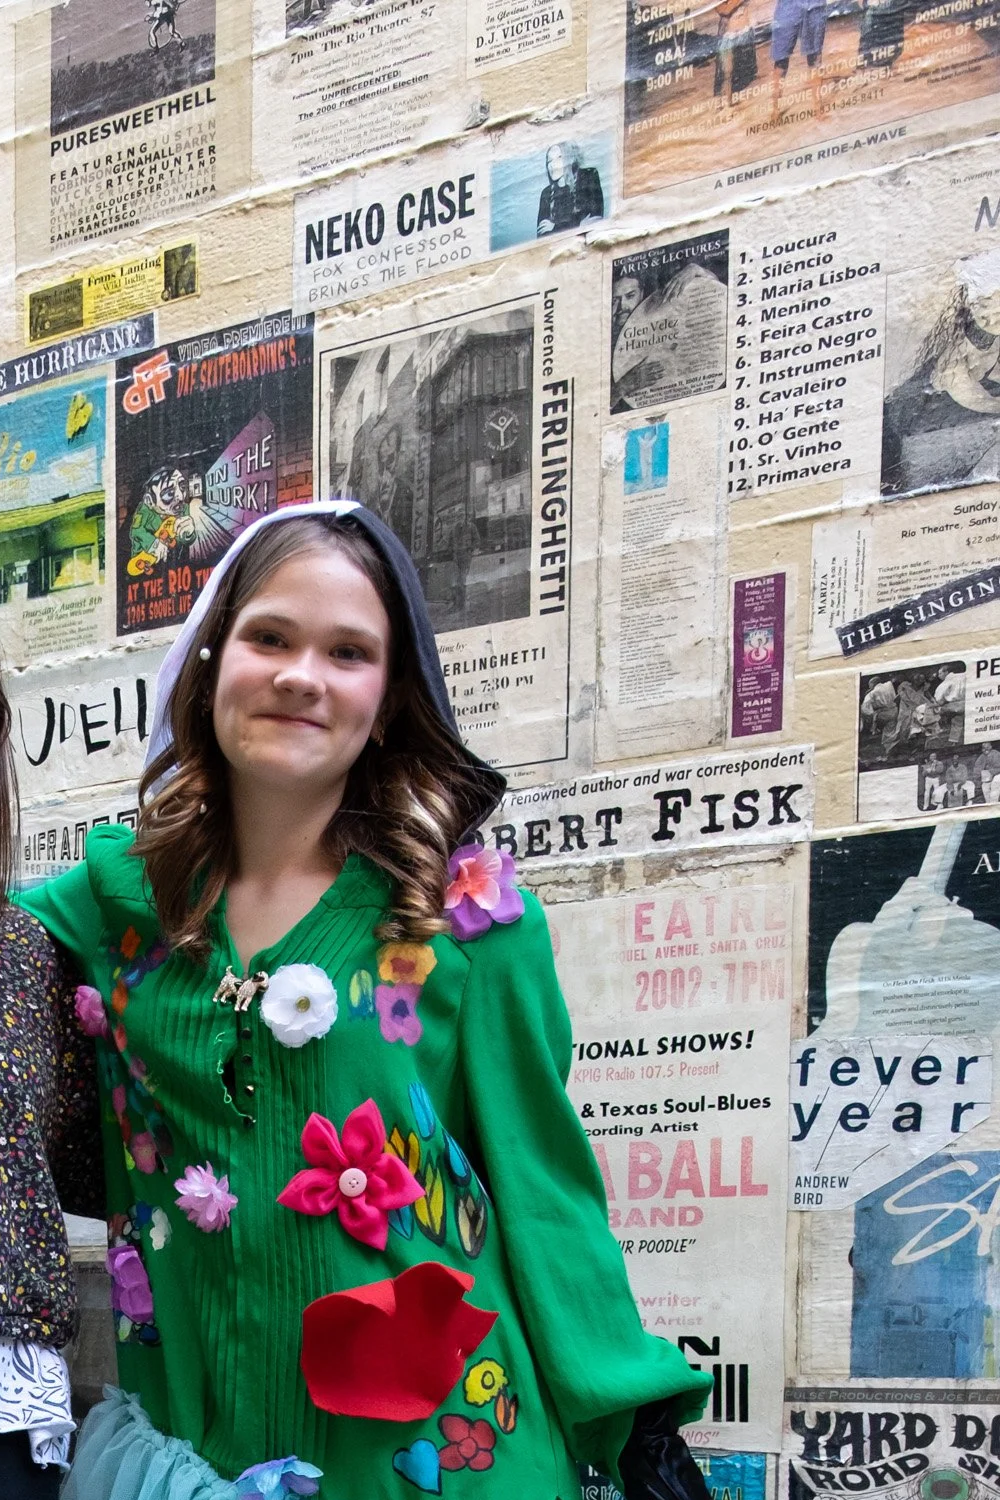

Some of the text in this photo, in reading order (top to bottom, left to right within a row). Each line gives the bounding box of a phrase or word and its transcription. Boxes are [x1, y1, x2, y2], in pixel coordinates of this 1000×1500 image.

[297, 73, 429, 122] The 2000 Presidential Election
[646, 68, 694, 92] 9:00 PM
[713, 125, 908, 191] A BENEFIT FOR RIDE-A-WAVE
[305, 173, 475, 265] NEKO CASE
[309, 246, 472, 303] BRINGS THE FLOOD
[313, 227, 466, 283] FOX CONFESSOR
[619, 240, 721, 276] ARTS & LECTURES
[737, 262, 881, 307] 3. Maria Lisboa
[542, 286, 559, 377] Lawrence
[624, 318, 679, 340] Glen Velez
[735, 327, 877, 370] 6. Barco Negro
[736, 307, 873, 349] 5. Feira Castro
[13, 323, 141, 386] HURRICANE
[208, 434, 272, 487] IN THE
[728, 440, 842, 474] 11. Sr. Vinho
[539, 379, 568, 615] FERLINGHETTI
[127, 565, 191, 603] AT THE RIO
[510, 751, 805, 807] renowned author and war correspondent
[656, 1029, 755, 1056] SHOWS!
[573, 1061, 720, 1084] KPIG Radio 107.5 Present
[795, 1047, 981, 1087] fever
[581, 1094, 771, 1118] & Texas Soul-Blues
[791, 1100, 975, 1142] year
[650, 1121, 699, 1135] Artist
[627, 1135, 769, 1201] BALL
[795, 1175, 850, 1188] ANDREW
[794, 1192, 823, 1205] BIRD
[655, 1316, 703, 1326] Artist
